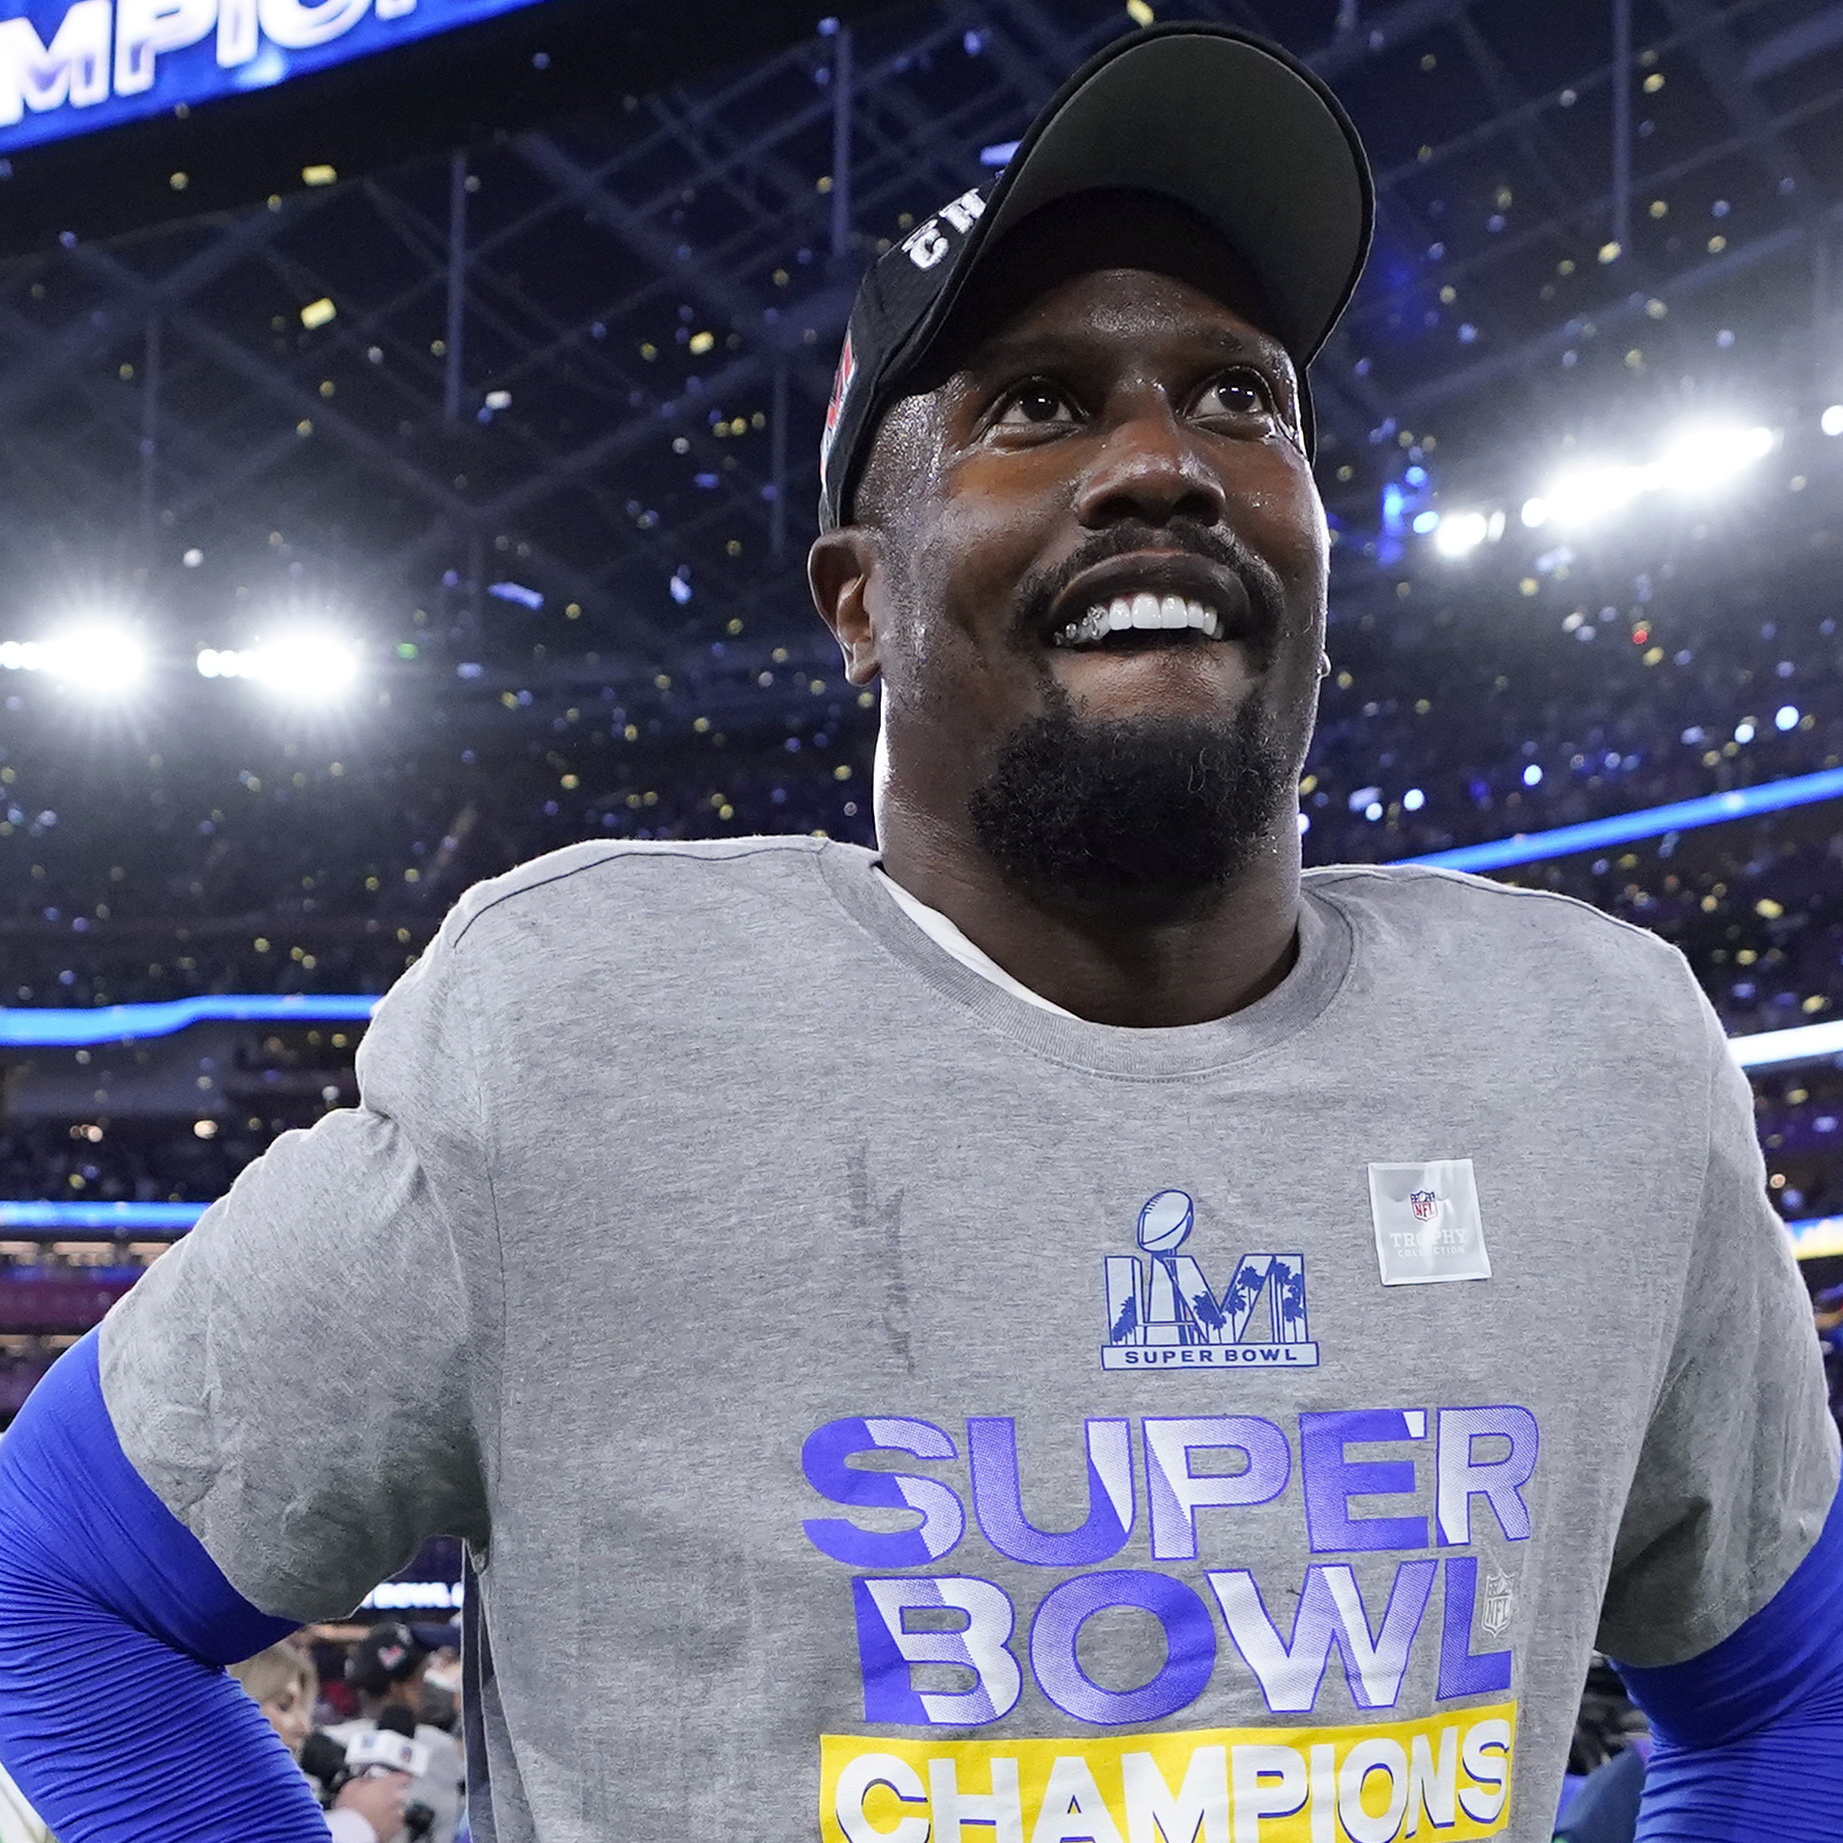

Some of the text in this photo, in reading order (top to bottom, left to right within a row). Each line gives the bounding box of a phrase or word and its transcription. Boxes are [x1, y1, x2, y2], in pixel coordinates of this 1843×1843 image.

[1414, 1201, 1436, 1218] NFL
[1125, 1347, 1297, 1364] SUPER BOWL
[801, 1404, 1539, 1568] SUPER
[850, 1556, 1512, 1727] BOWL
